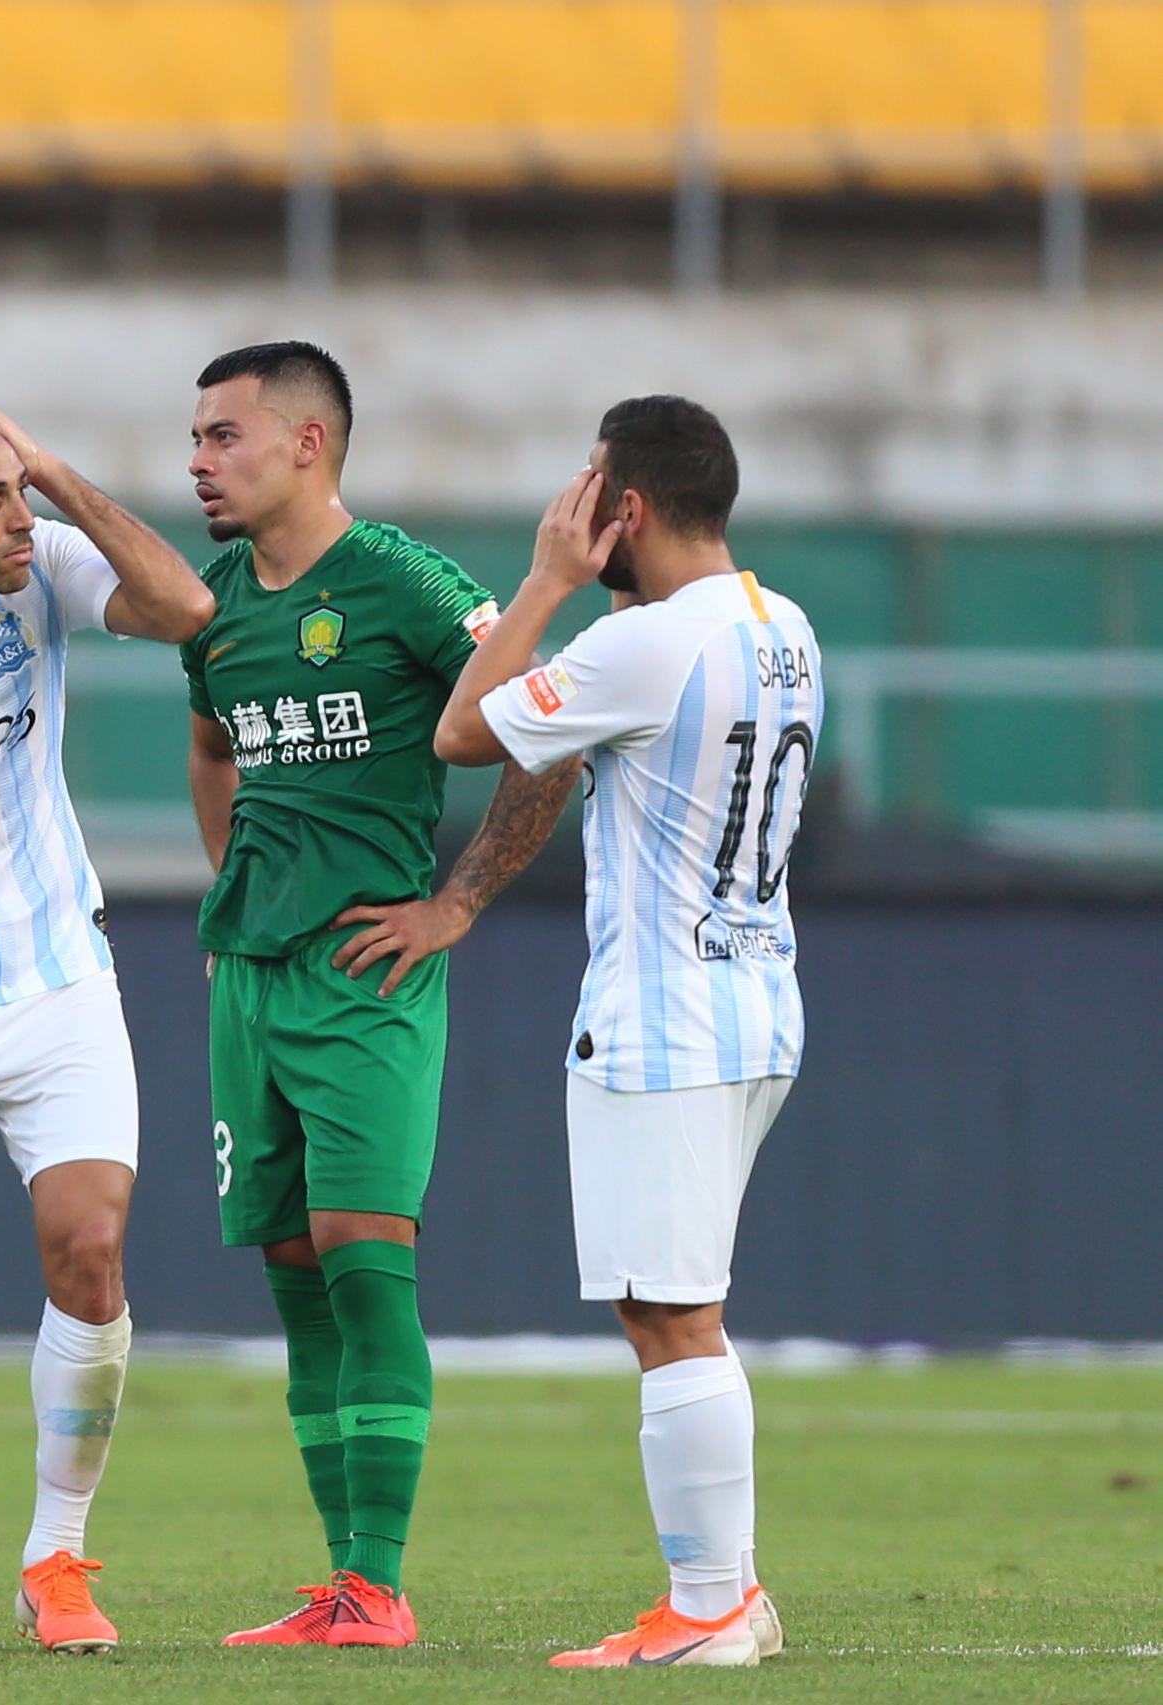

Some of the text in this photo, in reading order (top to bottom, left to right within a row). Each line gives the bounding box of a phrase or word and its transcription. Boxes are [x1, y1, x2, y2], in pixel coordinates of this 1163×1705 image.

[756, 646, 813, 689] SABA
[280, 739, 371, 764] GROUP
[712, 720, 814, 904] 10
